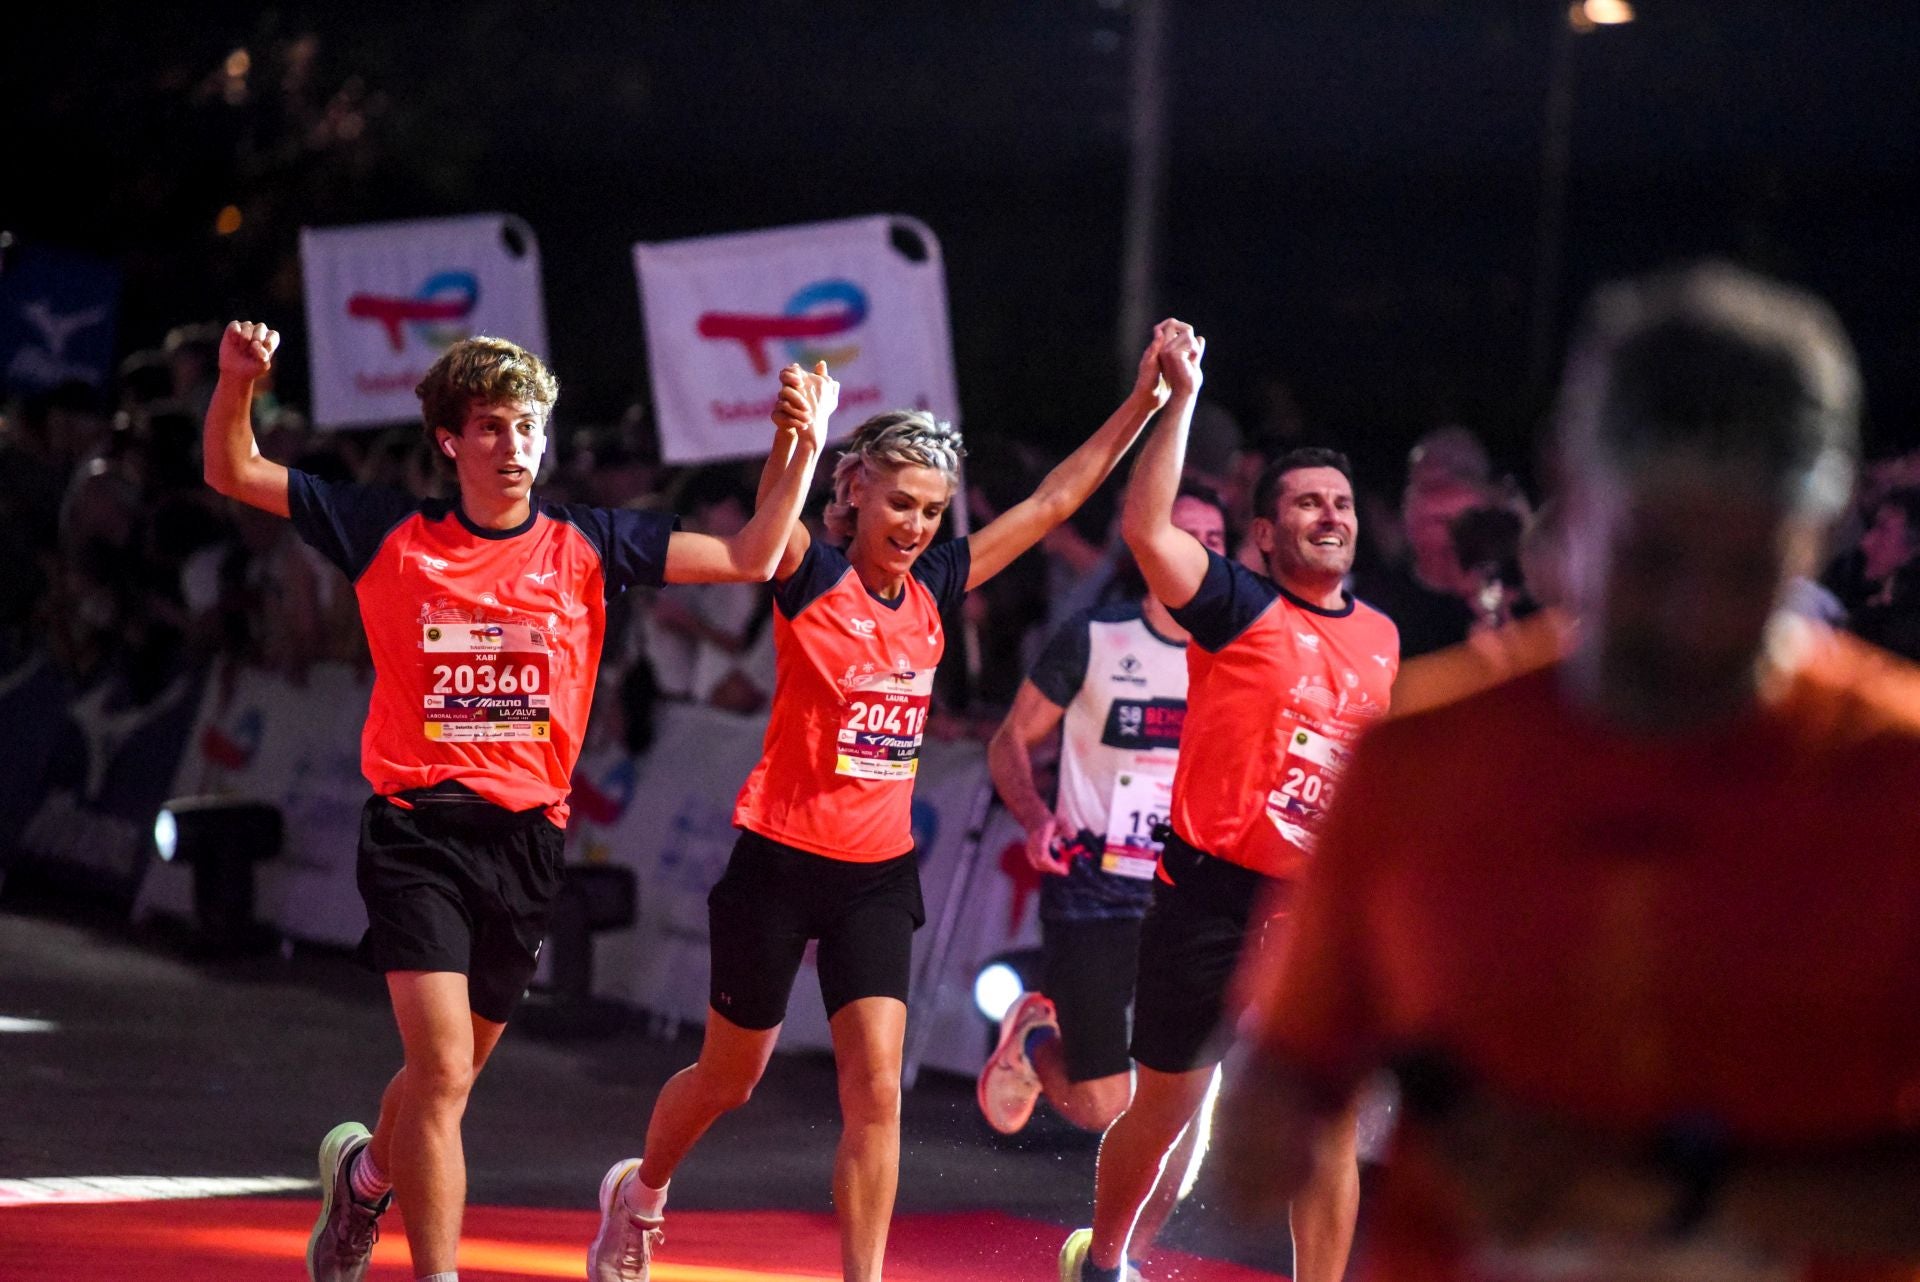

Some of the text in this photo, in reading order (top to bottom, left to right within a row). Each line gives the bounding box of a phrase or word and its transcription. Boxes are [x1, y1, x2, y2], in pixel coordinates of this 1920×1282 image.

[432, 664, 540, 694] 20360
[885, 694, 909, 703] LAURA
[847, 701, 926, 734] 20418
[537, 726, 545, 736] 3
